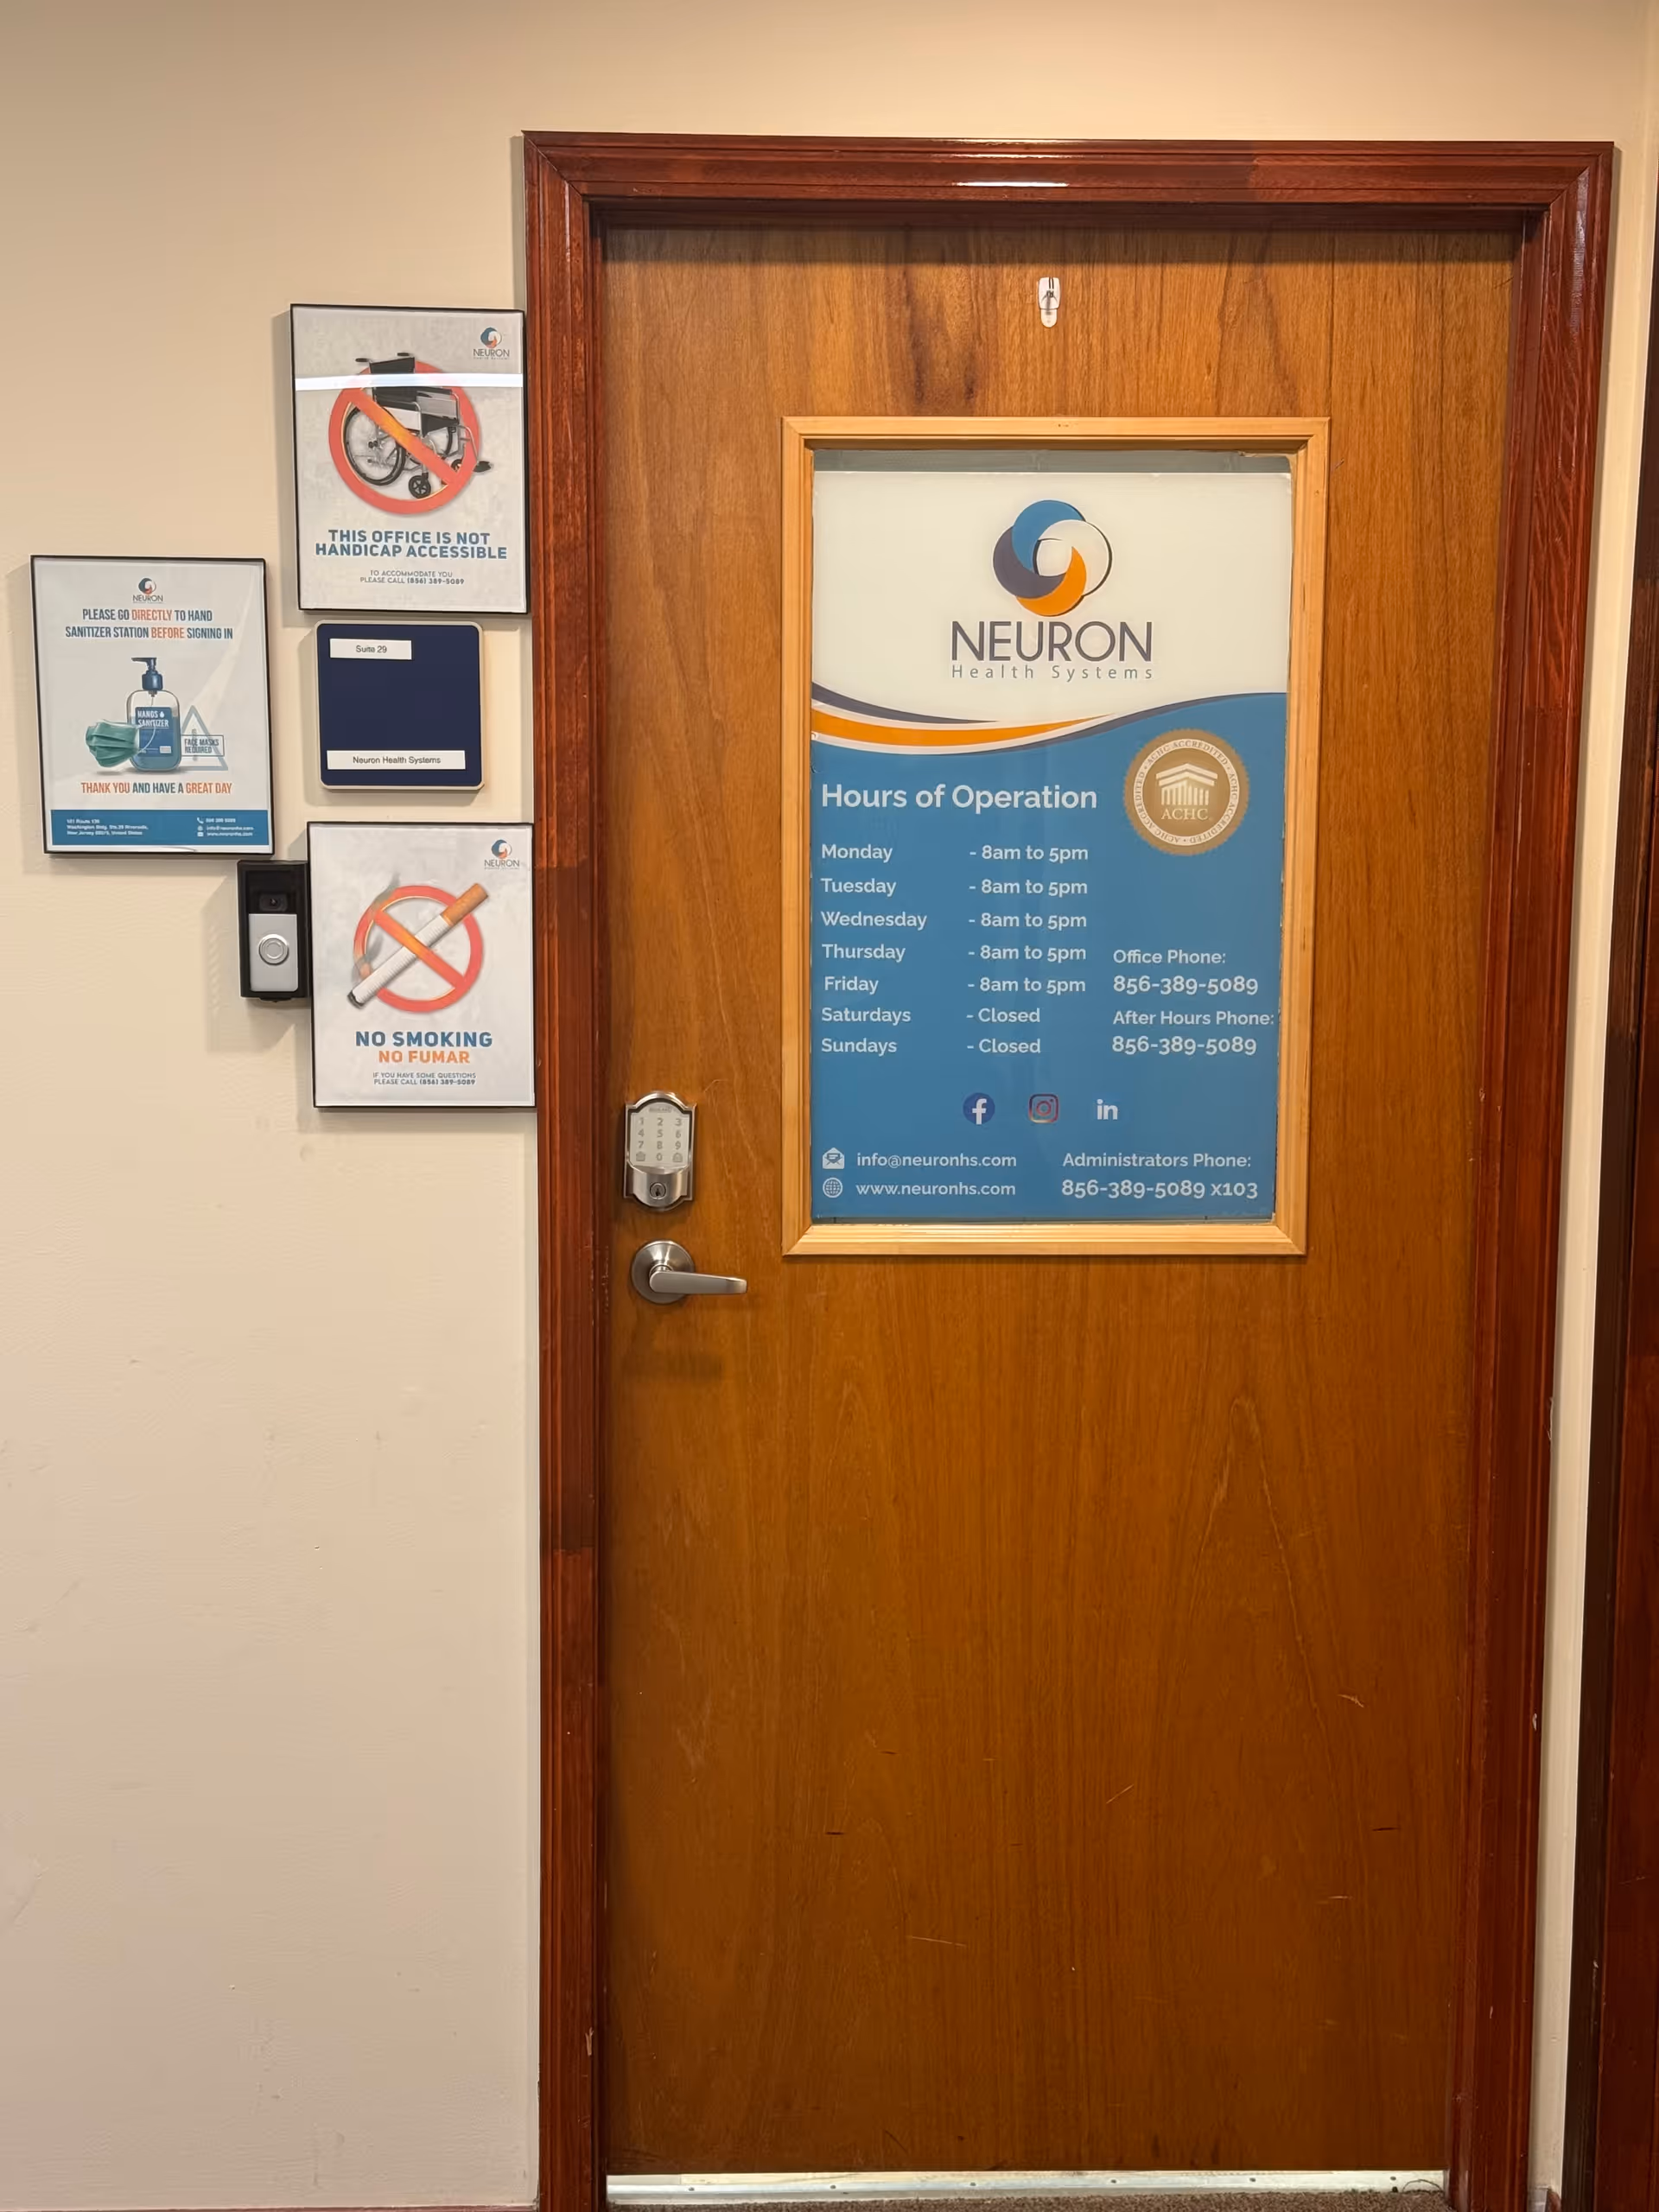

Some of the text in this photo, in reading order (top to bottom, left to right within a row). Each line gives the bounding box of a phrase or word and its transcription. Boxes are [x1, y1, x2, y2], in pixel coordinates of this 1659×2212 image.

[328, 530, 490, 545] THIS OFFICE IS NOT
[315, 543, 506, 559] HANDICAP ACCESSIBLE
[83, 609, 213, 621] PLEASE GO DIRECTLY TO HAND
[66, 626, 232, 639] SANITIZER STATION BEFORE SIGNING IN
[951, 620, 1152, 662] NEURON
[355, 645, 387, 654] Suite 29
[951, 664, 1154, 682] Health Systems
[353, 755, 441, 766] Neuron Health Systems
[81, 782, 232, 794] THANK YOU AND HAVE A GREAT DAY
[821, 784, 1097, 814] Hours of Operation
[1161, 808, 1208, 820] ACHC
[821, 844, 893, 862] Monday
[982, 844, 1021, 861] 8am
[1026, 845, 1044, 861] to
[1048, 847, 1088, 863] 5pm
[820, 878, 896, 896] Tuesday
[982, 878, 1020, 894] 8am
[1025, 880, 1044, 894] to
[1048, 880, 1088, 897] 5pm
[821, 911, 928, 930] Wednesday
[981, 912, 1020, 928] 8am
[1025, 913, 1043, 928] to
[1048, 914, 1087, 931] 5pm
[821, 944, 906, 962] Thursday
[981, 944, 1020, 960] 8am
[1024, 945, 1043, 960] to
[1047, 947, 1087, 963] 5pm
[1113, 949, 1226, 965] Office Phone:
[823, 976, 879, 995] Friday
[980, 976, 1020, 993] 8am
[1024, 977, 1042, 993] to
[1046, 979, 1087, 995] 5pm
[1113, 976, 1258, 995] 856-389-5089
[821, 1007, 912, 1026] Saturdays
[978, 1007, 1040, 1024] Closed
[1113, 1009, 1274, 1027] After Hours Phone:
[355, 1031, 493, 1047] NO SMOKING
[1112, 1036, 1257, 1056] 856-389-5089
[821, 1039, 898, 1057] Sundays
[978, 1039, 1041, 1055] Closed
[378, 1050, 470, 1065] NO FUMAR
[657, 1141, 663, 1149] 8
[656, 1153, 662, 1161] 0
[856, 1152, 1017, 1169] info@neuronhs.com
[1063, 1153, 1251, 1169] Administrators Phone:
[855, 1181, 1016, 1197] www.neuronhs.com
[1061, 1179, 1258, 1200] 856-389-5089 x103
